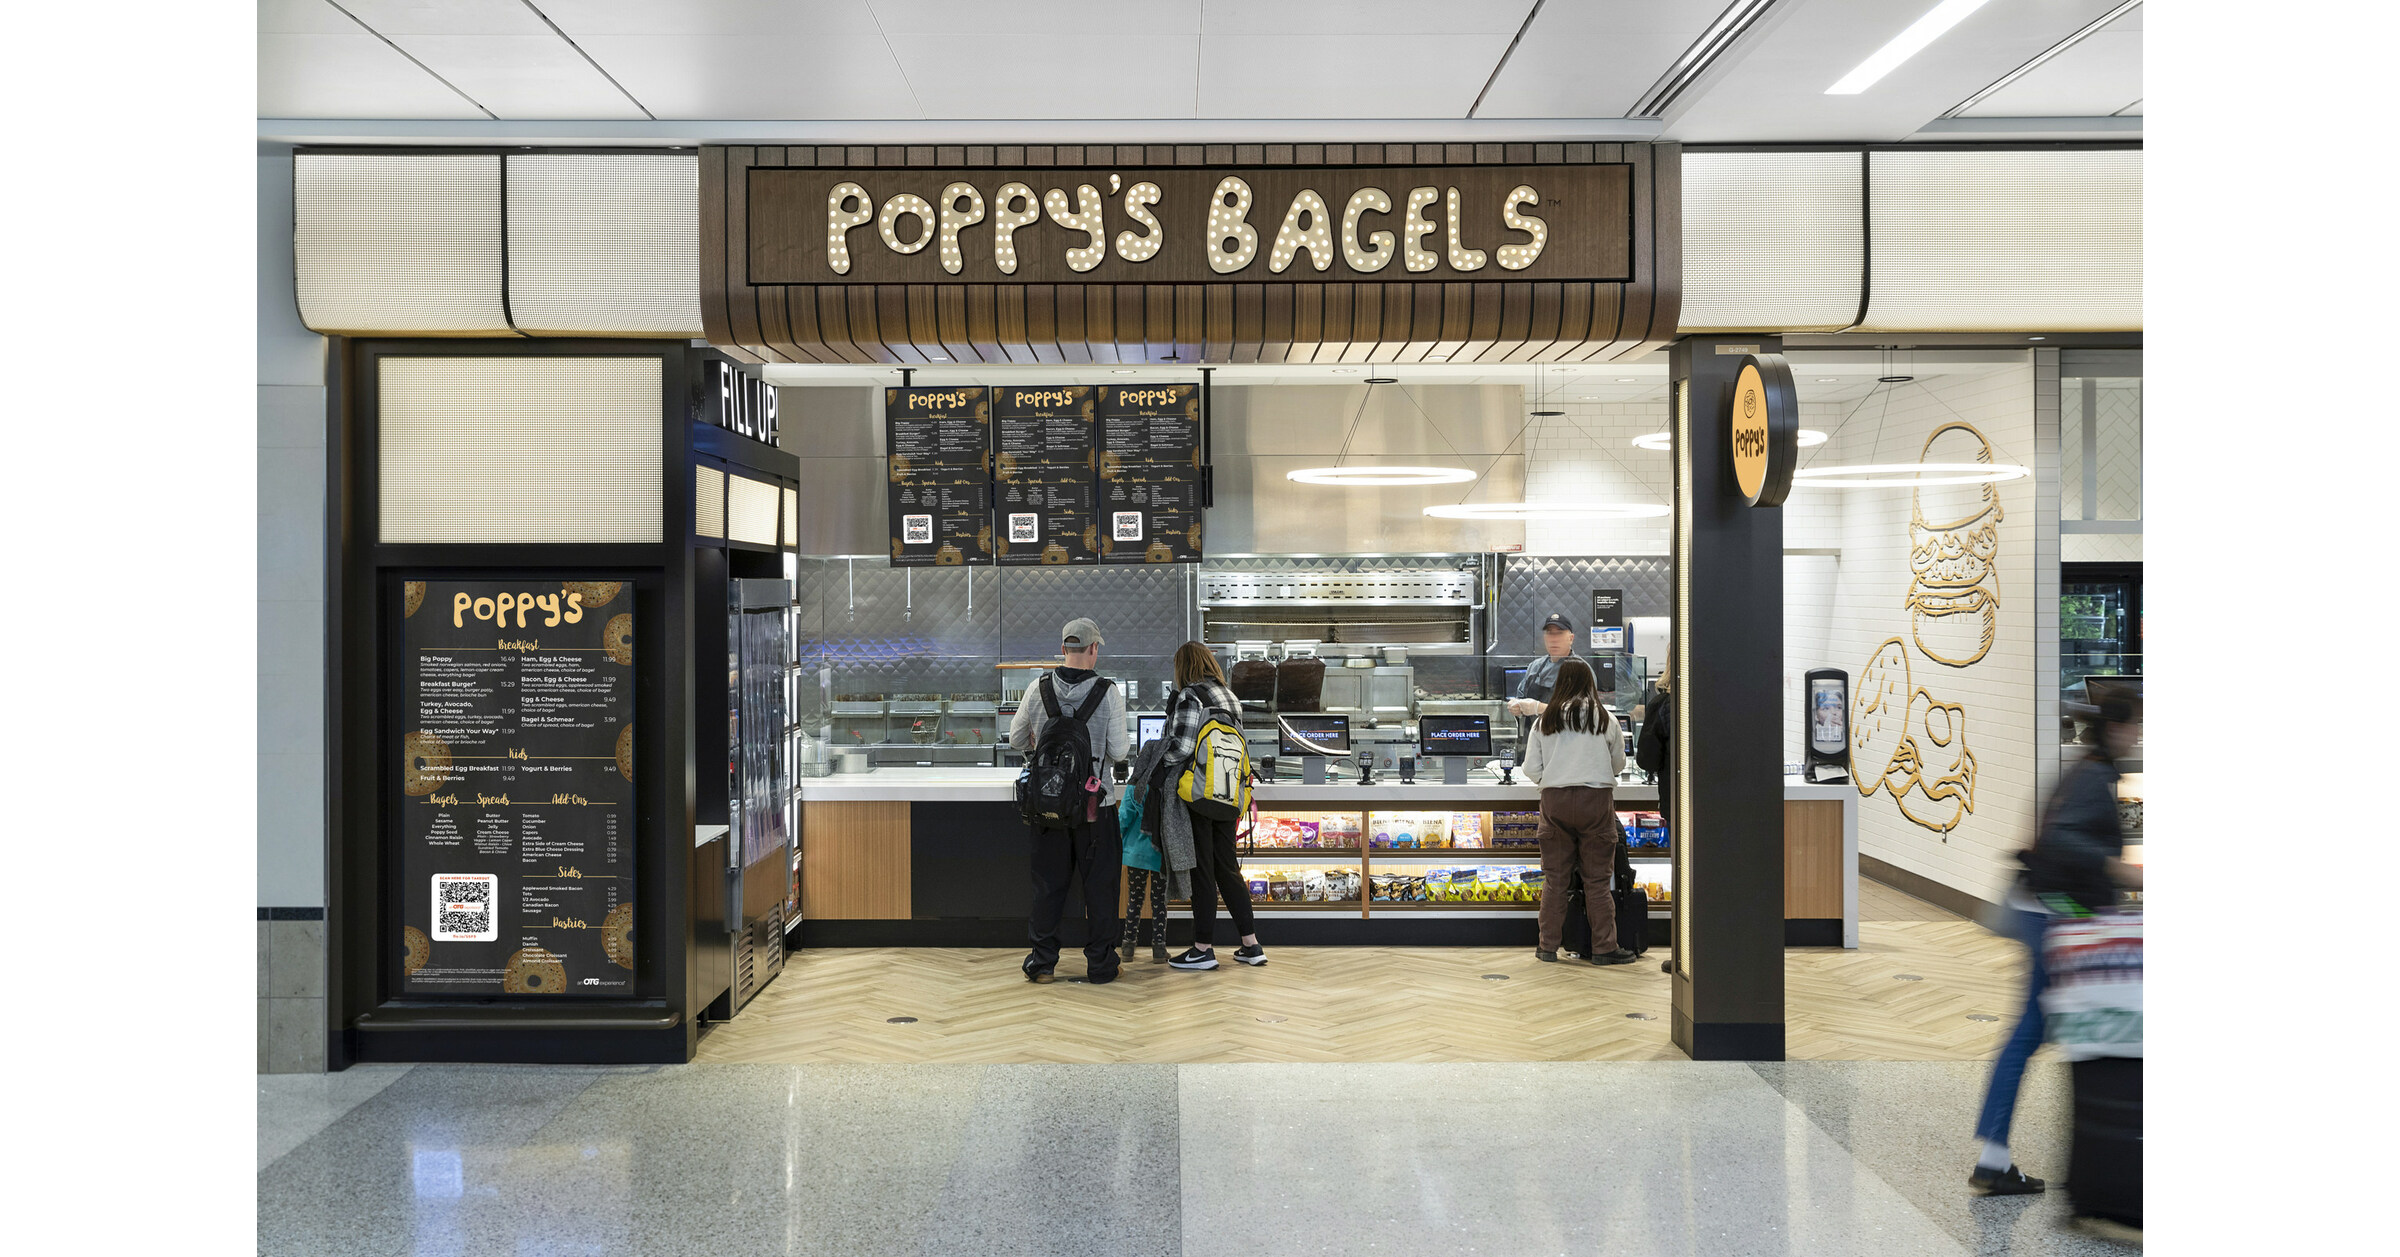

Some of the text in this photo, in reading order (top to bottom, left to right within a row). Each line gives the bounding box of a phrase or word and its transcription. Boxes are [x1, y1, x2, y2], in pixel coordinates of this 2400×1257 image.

[827, 174, 1164, 275] POPPY'S
[1208, 175, 1548, 275] BAGELS
[720, 361, 780, 447] FILL UP!
[909, 392, 966, 410] POPPY'S
[1015, 390, 1073, 408] POPPY'S
[1120, 389, 1177, 407] POPPY'S
[1735, 427, 1765, 458] POPPY'S
[453, 589, 583, 628] POPPY'S
[498, 639, 539, 652] Breakfast
[521, 676, 543, 684] Bacon,
[544, 676, 557, 684] Egg
[508, 748, 529, 761] Kids
[430, 793, 459, 808] Bagels
[476, 792, 511, 808] Spreads
[551, 793, 588, 806] Add-Ons
[558, 866, 582, 879] Sides
[553, 916, 587, 930] Pastries
